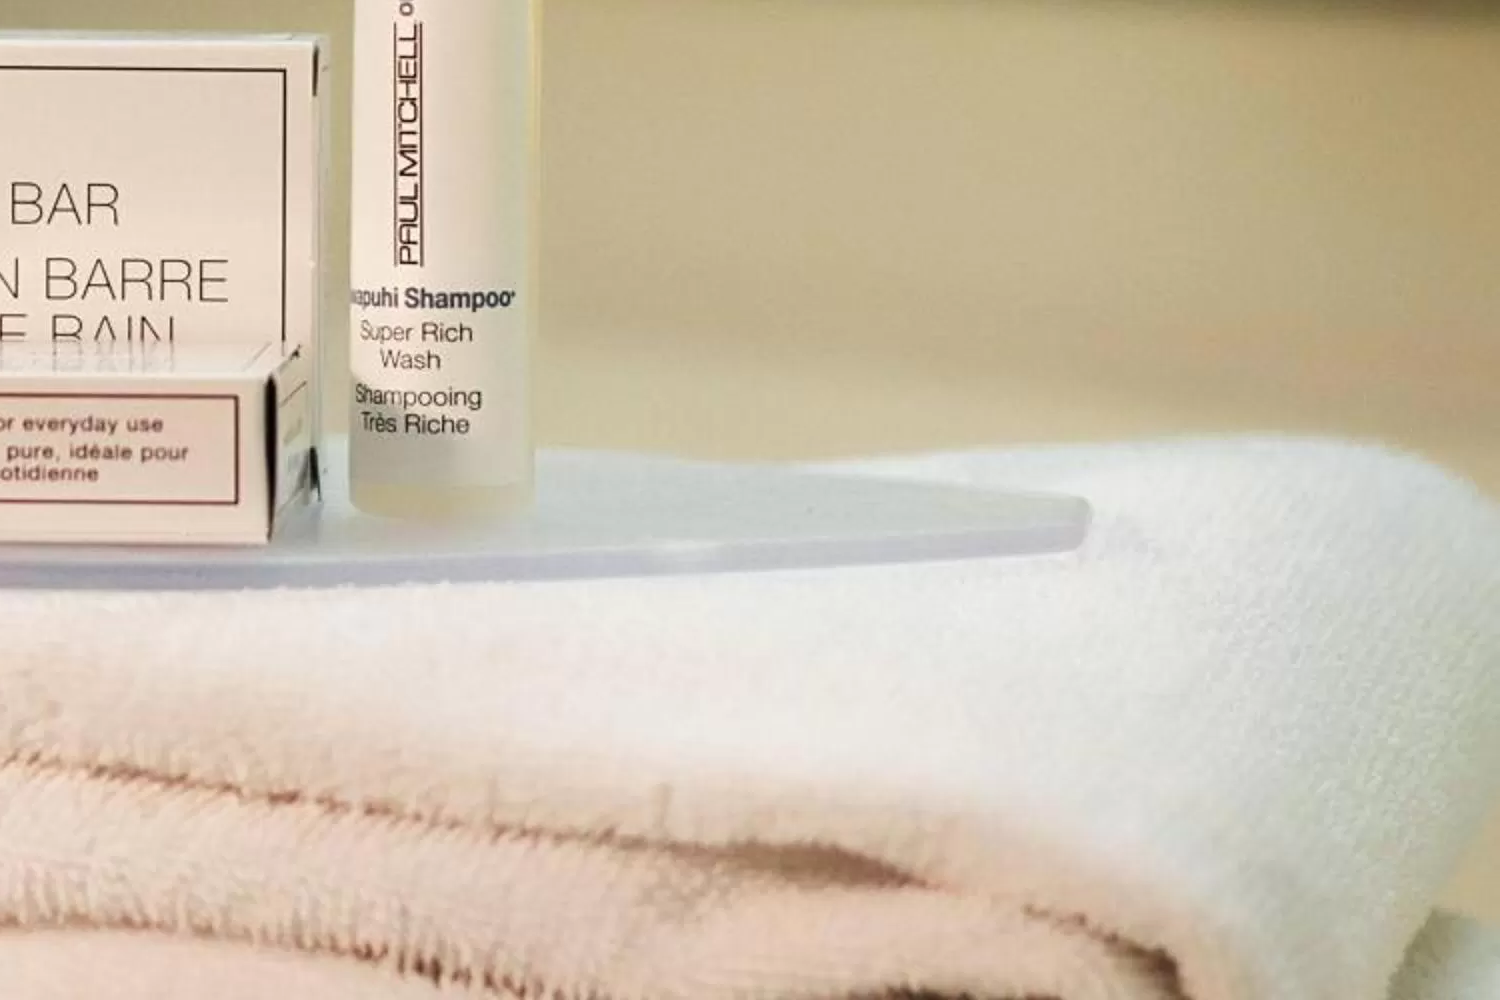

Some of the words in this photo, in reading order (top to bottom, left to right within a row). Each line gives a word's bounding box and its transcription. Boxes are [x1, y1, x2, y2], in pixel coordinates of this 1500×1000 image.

[397, 23, 419, 178] MITCHELL
[10, 182, 120, 226] BAR
[397, 183, 420, 265] PAUL
[45, 257, 229, 302] BARRE
[360, 319, 414, 343] Super
[421, 322, 473, 342] Rich
[380, 350, 441, 369] Wash
[355, 383, 483, 411] Shampooing
[22, 415, 118, 435] everyday
[127, 417, 164, 433] use
[361, 411, 397, 433] Très
[405, 413, 470, 434] Riche
[6, 445, 61, 462] pure,
[69, 443, 133, 460] idéale
[141, 446, 189, 463] pour
